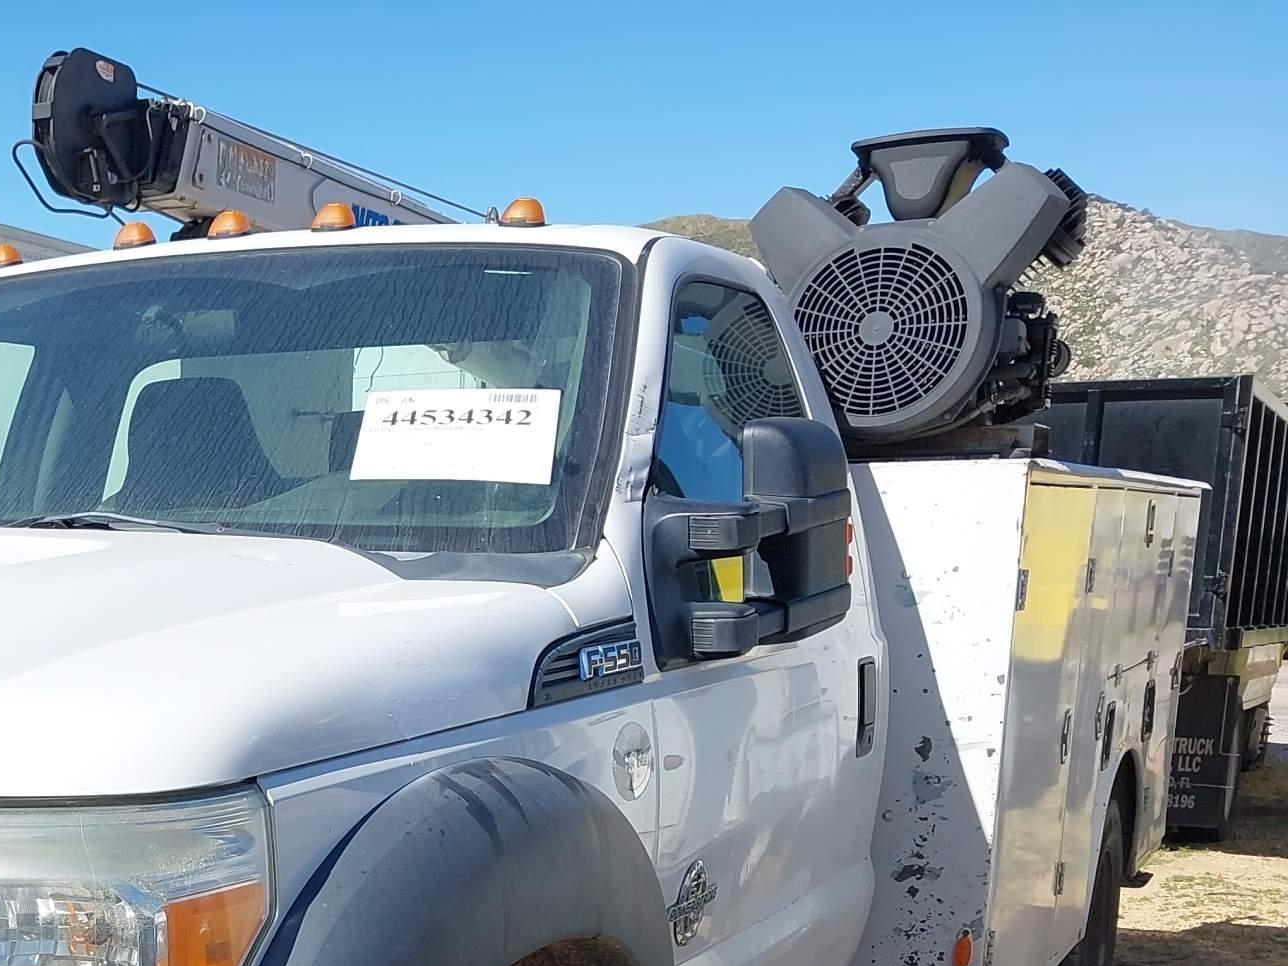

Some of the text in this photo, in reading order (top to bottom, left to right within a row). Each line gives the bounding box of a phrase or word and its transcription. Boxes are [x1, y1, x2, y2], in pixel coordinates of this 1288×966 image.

[381, 408, 533, 426] 44534342
[1173, 737, 1215, 755] TRUCK
[1177, 755, 1202, 773] LLC
